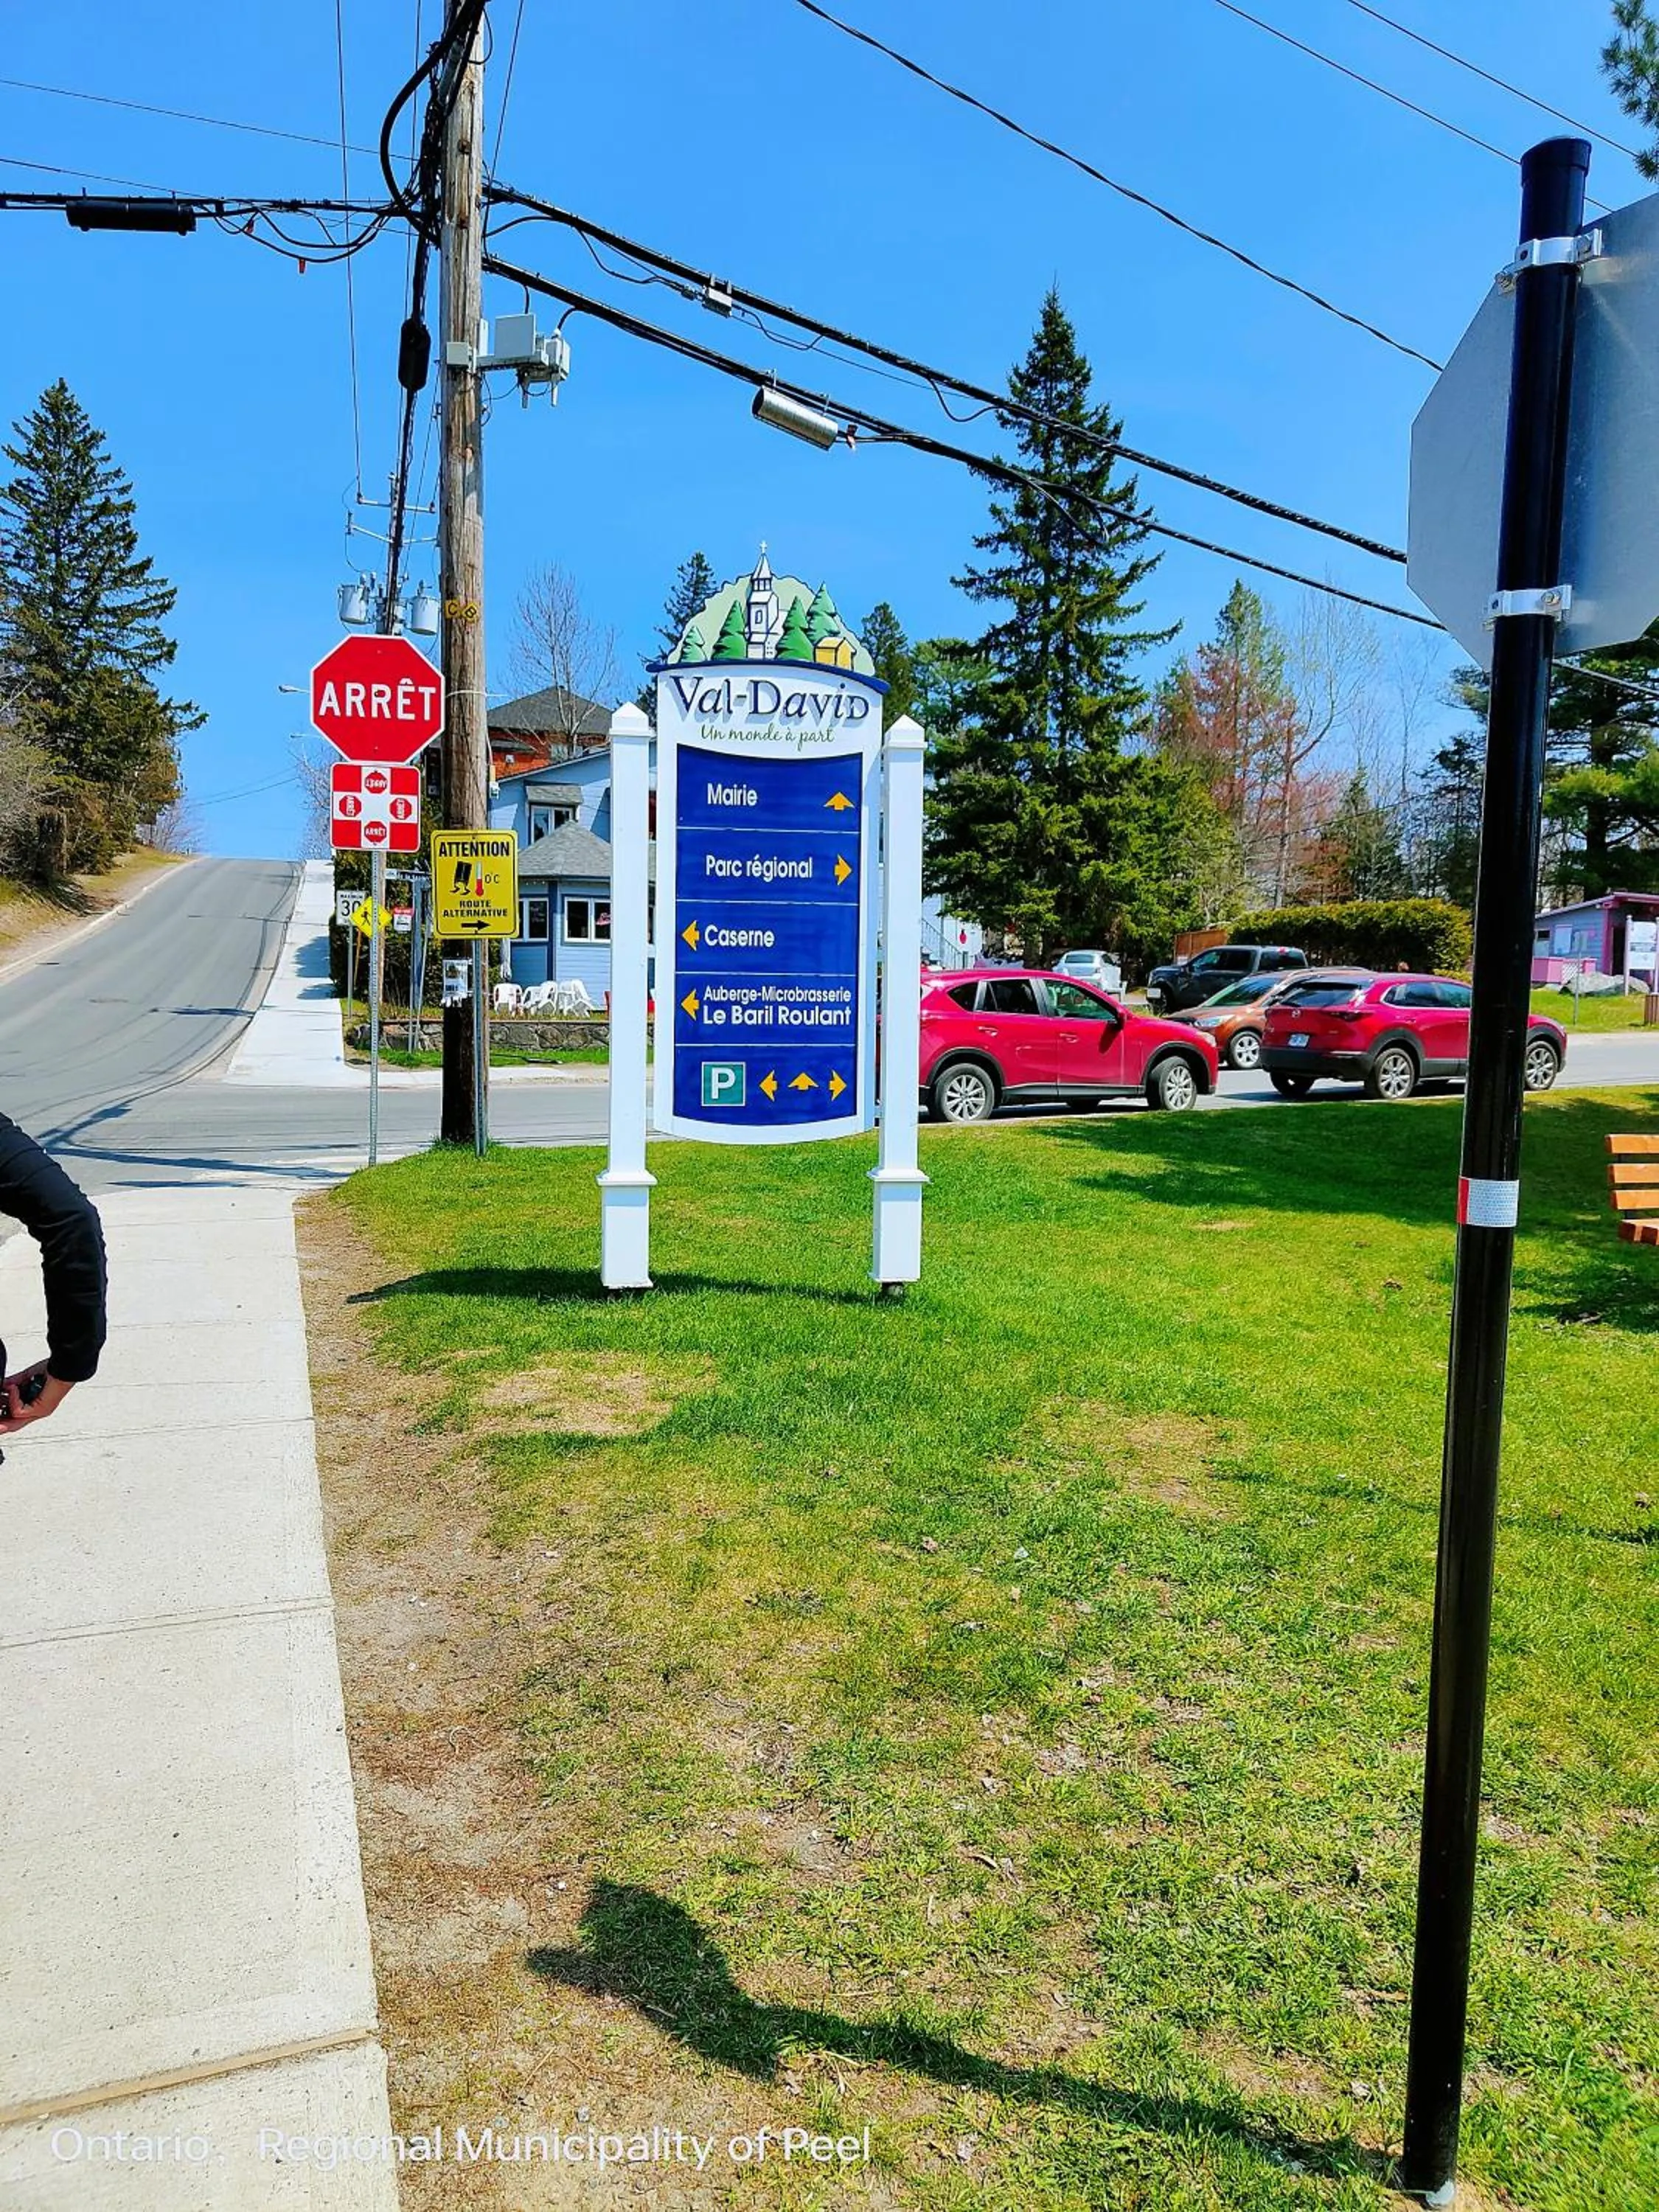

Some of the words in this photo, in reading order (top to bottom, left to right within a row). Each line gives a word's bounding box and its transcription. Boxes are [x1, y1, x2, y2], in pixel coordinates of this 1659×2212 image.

[319, 678, 436, 720] ARRÊT
[701, 725, 725, 741] Un
[731, 723, 782, 742] monde
[798, 726, 835, 751] part
[707, 783, 758, 807] Mairie
[439, 841, 509, 858] ATTENTION
[706, 855, 742, 877] Parc
[746, 854, 813, 883] régional
[443, 908, 508, 918] ALTERNATIVE
[459, 900, 492, 908] ROUTE
[704, 925, 775, 947] Caserne
[703, 985, 852, 1004] Auberge-Microbrasserie
[703, 1006, 726, 1025] Le
[731, 1006, 773, 1026] Baril
[778, 1006, 852, 1026] Roulant
[711, 1068, 736, 1099] P
